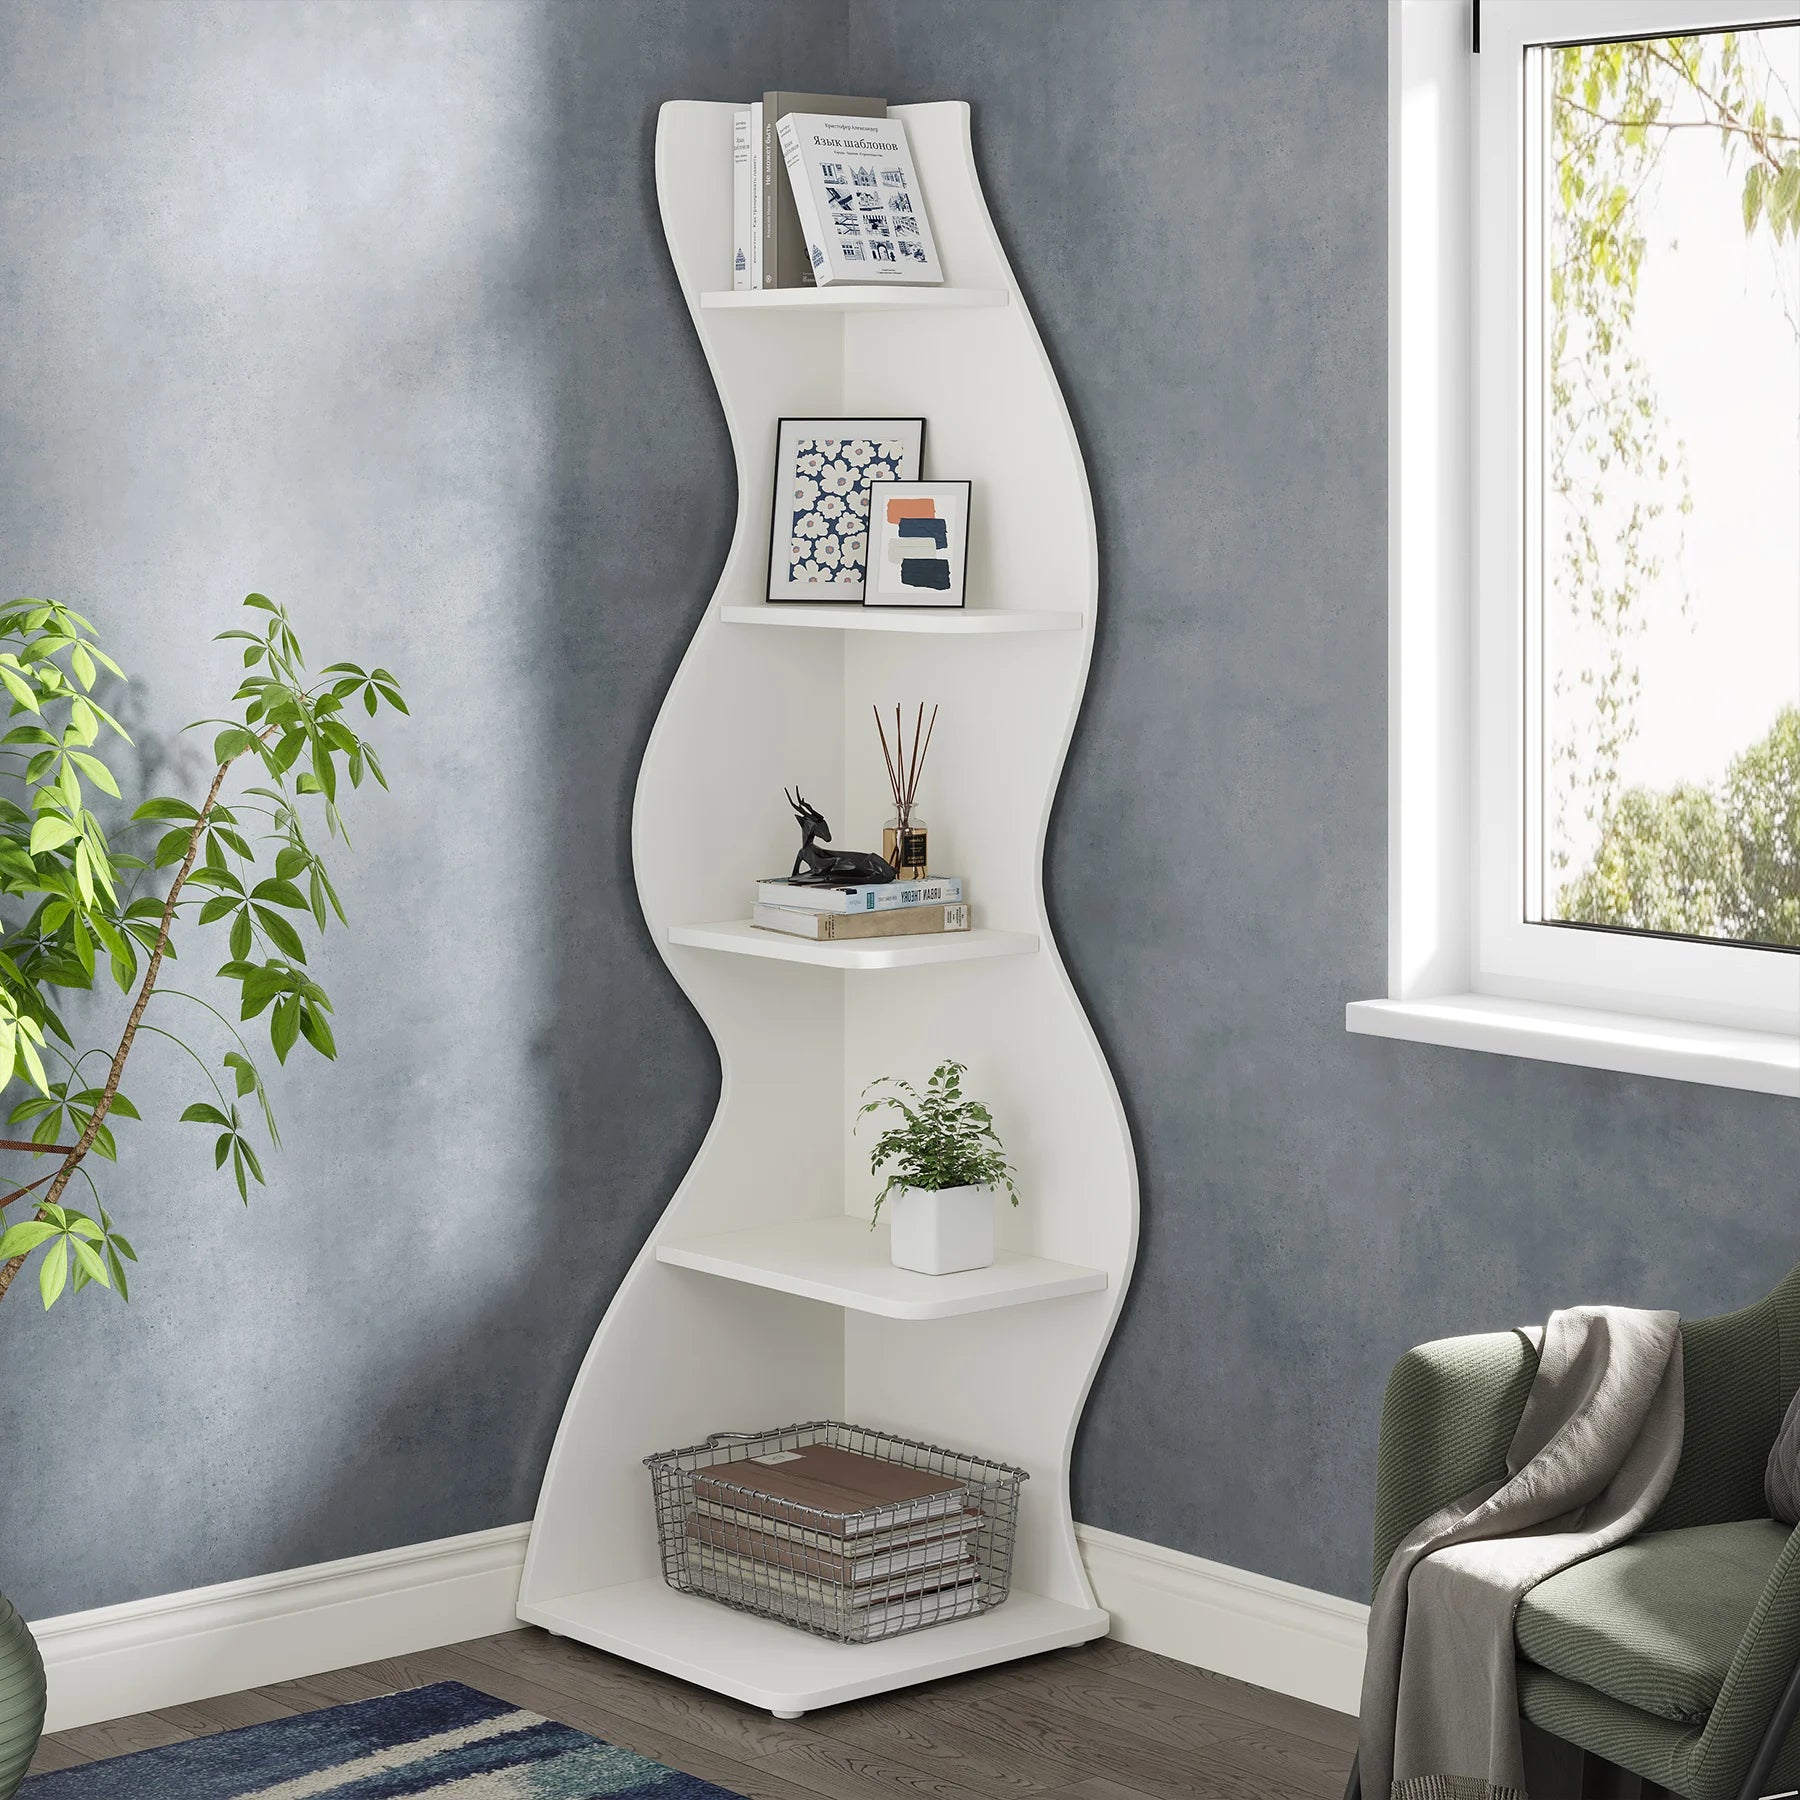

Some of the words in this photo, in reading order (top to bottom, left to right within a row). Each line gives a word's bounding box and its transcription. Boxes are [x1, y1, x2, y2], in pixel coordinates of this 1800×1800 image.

[813, 135, 842, 147] Язык
[843, 138, 899, 151] шаблонов
[765, 174, 771, 185] Не
